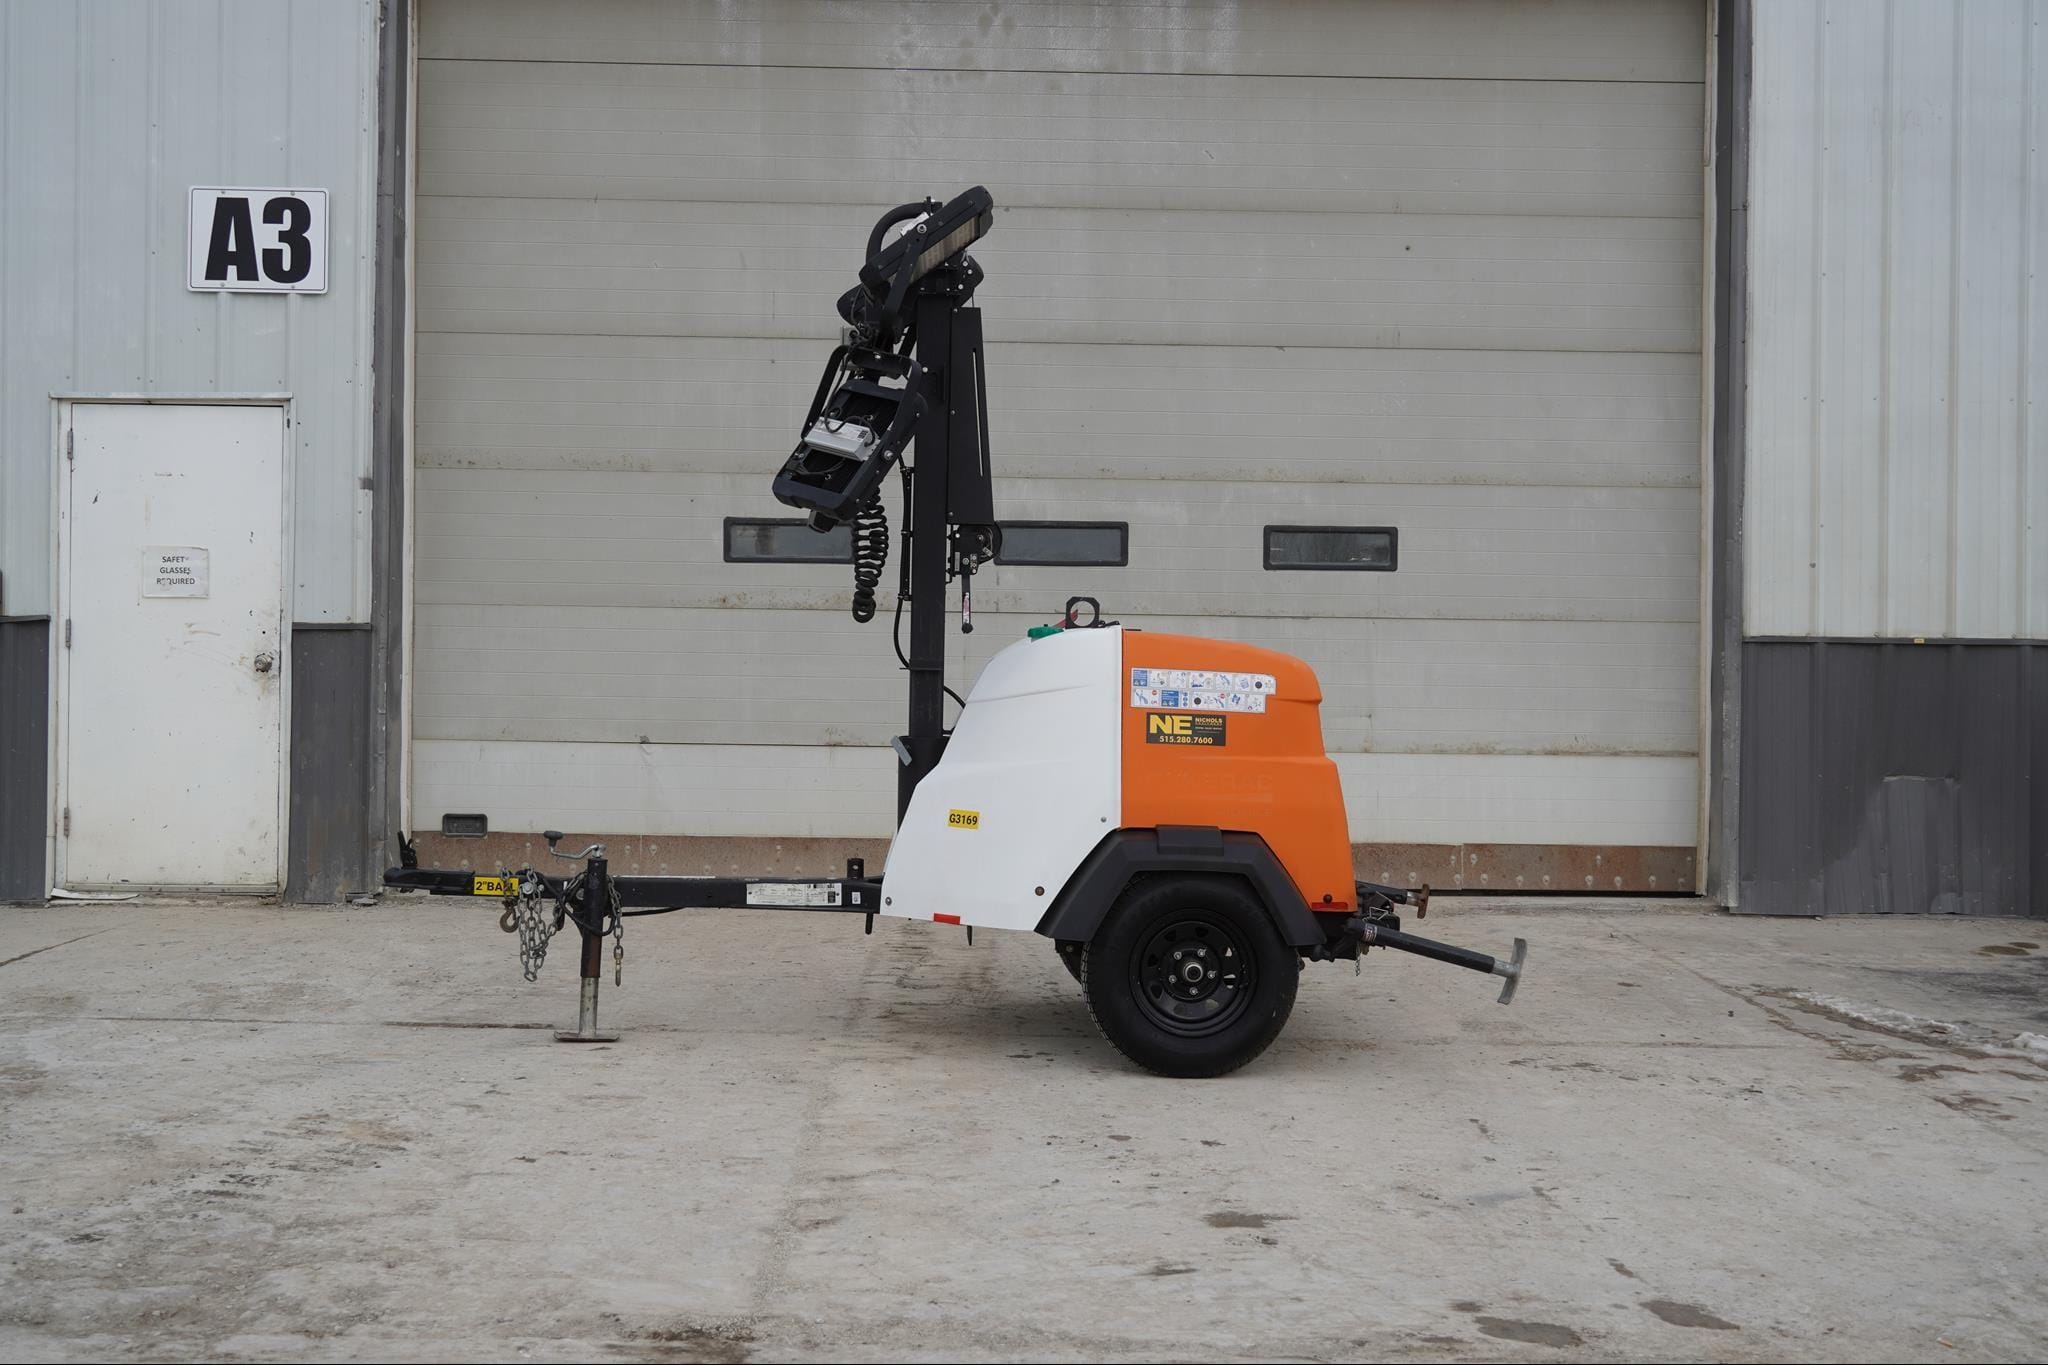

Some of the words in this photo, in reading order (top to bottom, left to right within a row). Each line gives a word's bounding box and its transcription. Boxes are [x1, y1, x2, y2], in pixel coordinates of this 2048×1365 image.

[204, 196, 312, 284] A3
[156, 577, 196, 585] RQUIRED
[1149, 714, 1193, 735] NE
[1159, 735, 1213, 744] 515.280.7600
[949, 813, 978, 825] G3169
